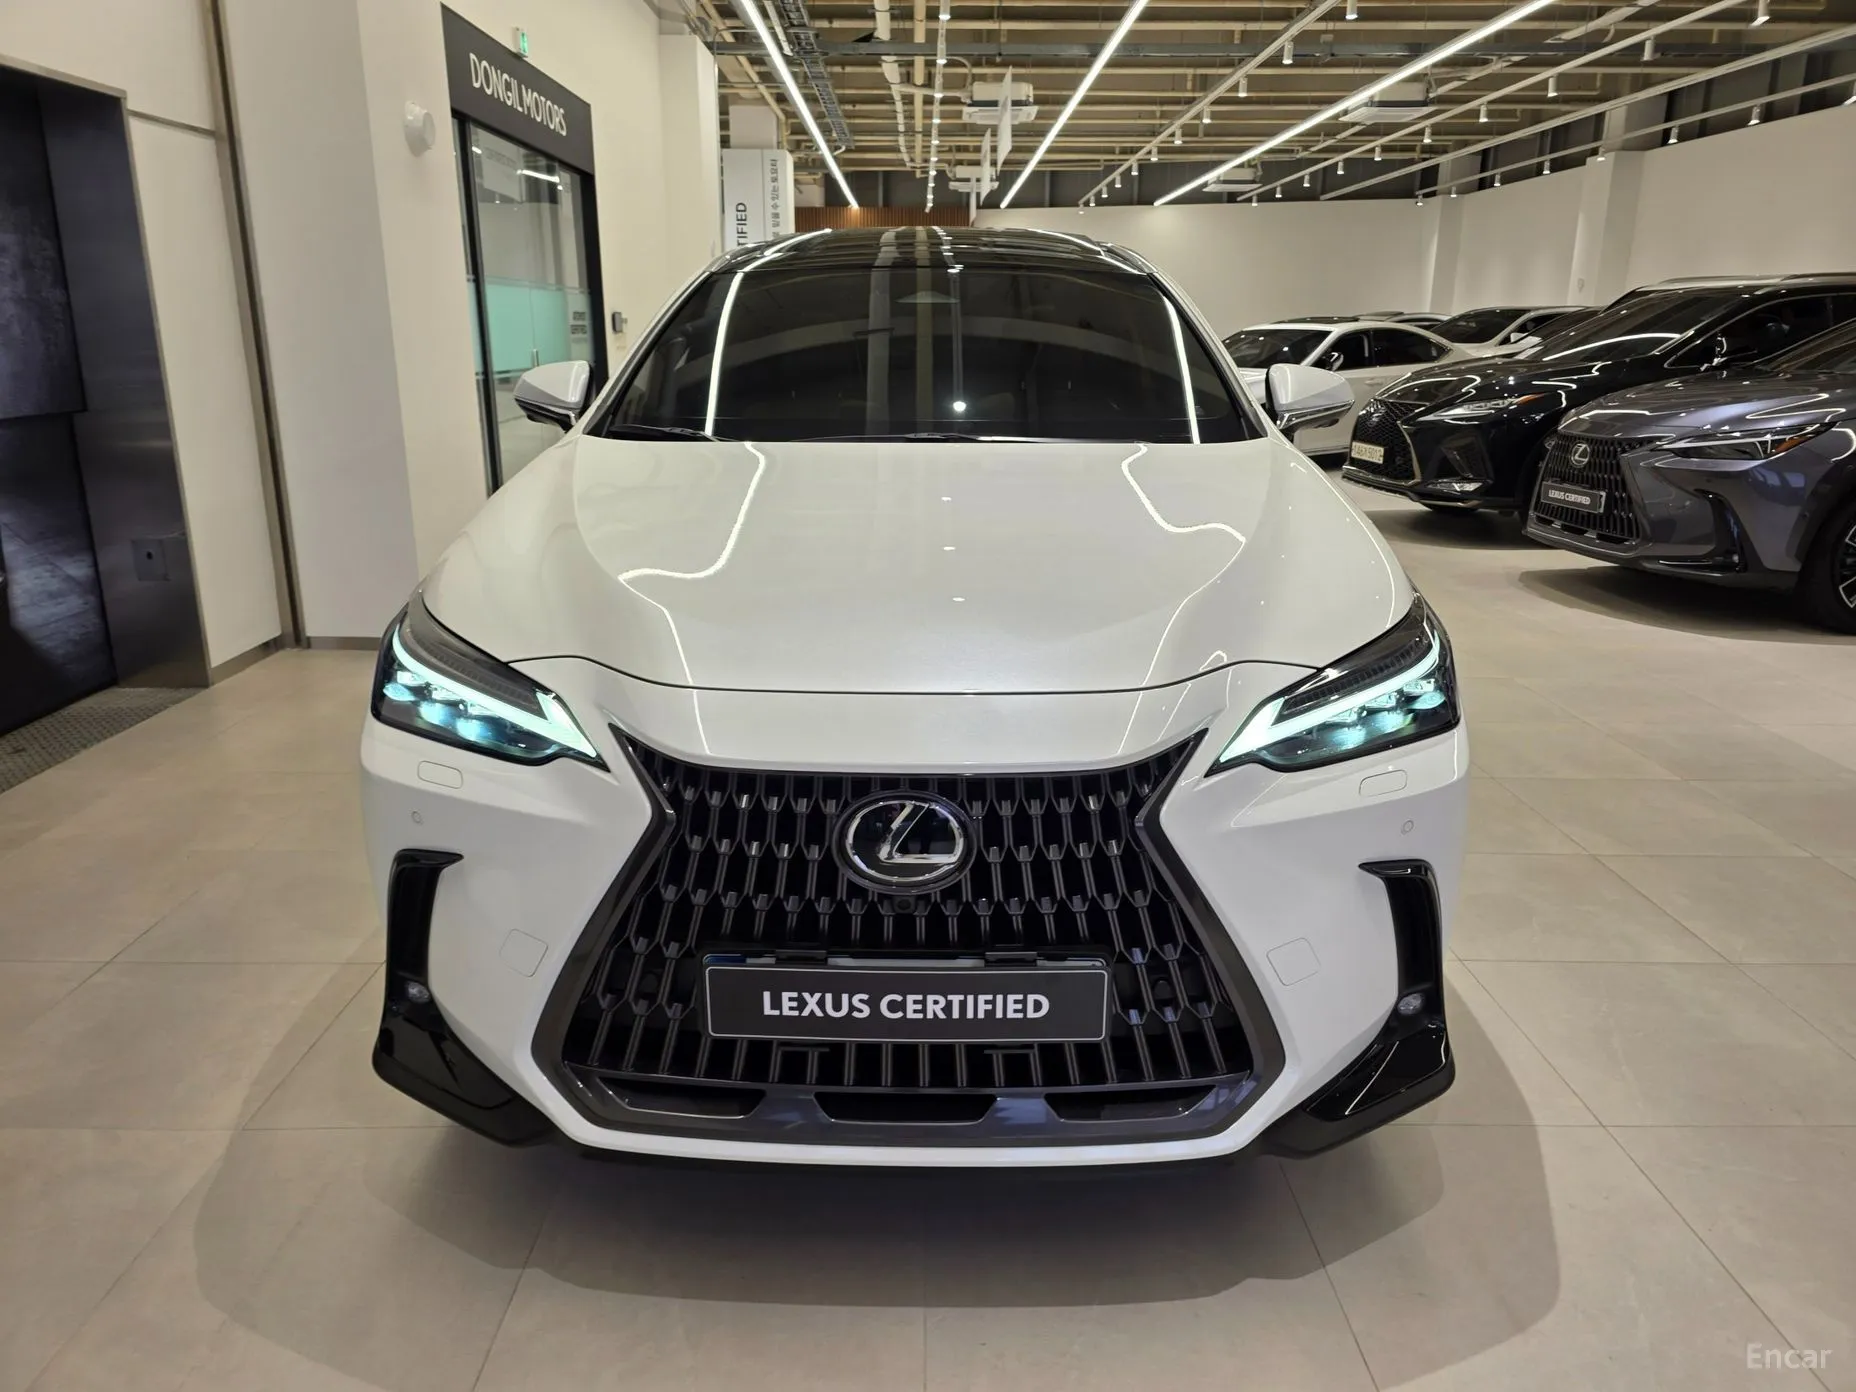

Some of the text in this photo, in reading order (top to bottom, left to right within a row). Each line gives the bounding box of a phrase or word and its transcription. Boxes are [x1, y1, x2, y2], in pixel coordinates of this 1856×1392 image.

[469, 52, 567, 136] DONGIL MOTORS
[770, 159, 778, 183] 토요타
[1548, 489, 1565, 500] LEXUS
[762, 991, 1050, 1019] LEXUS CERTIFIED
